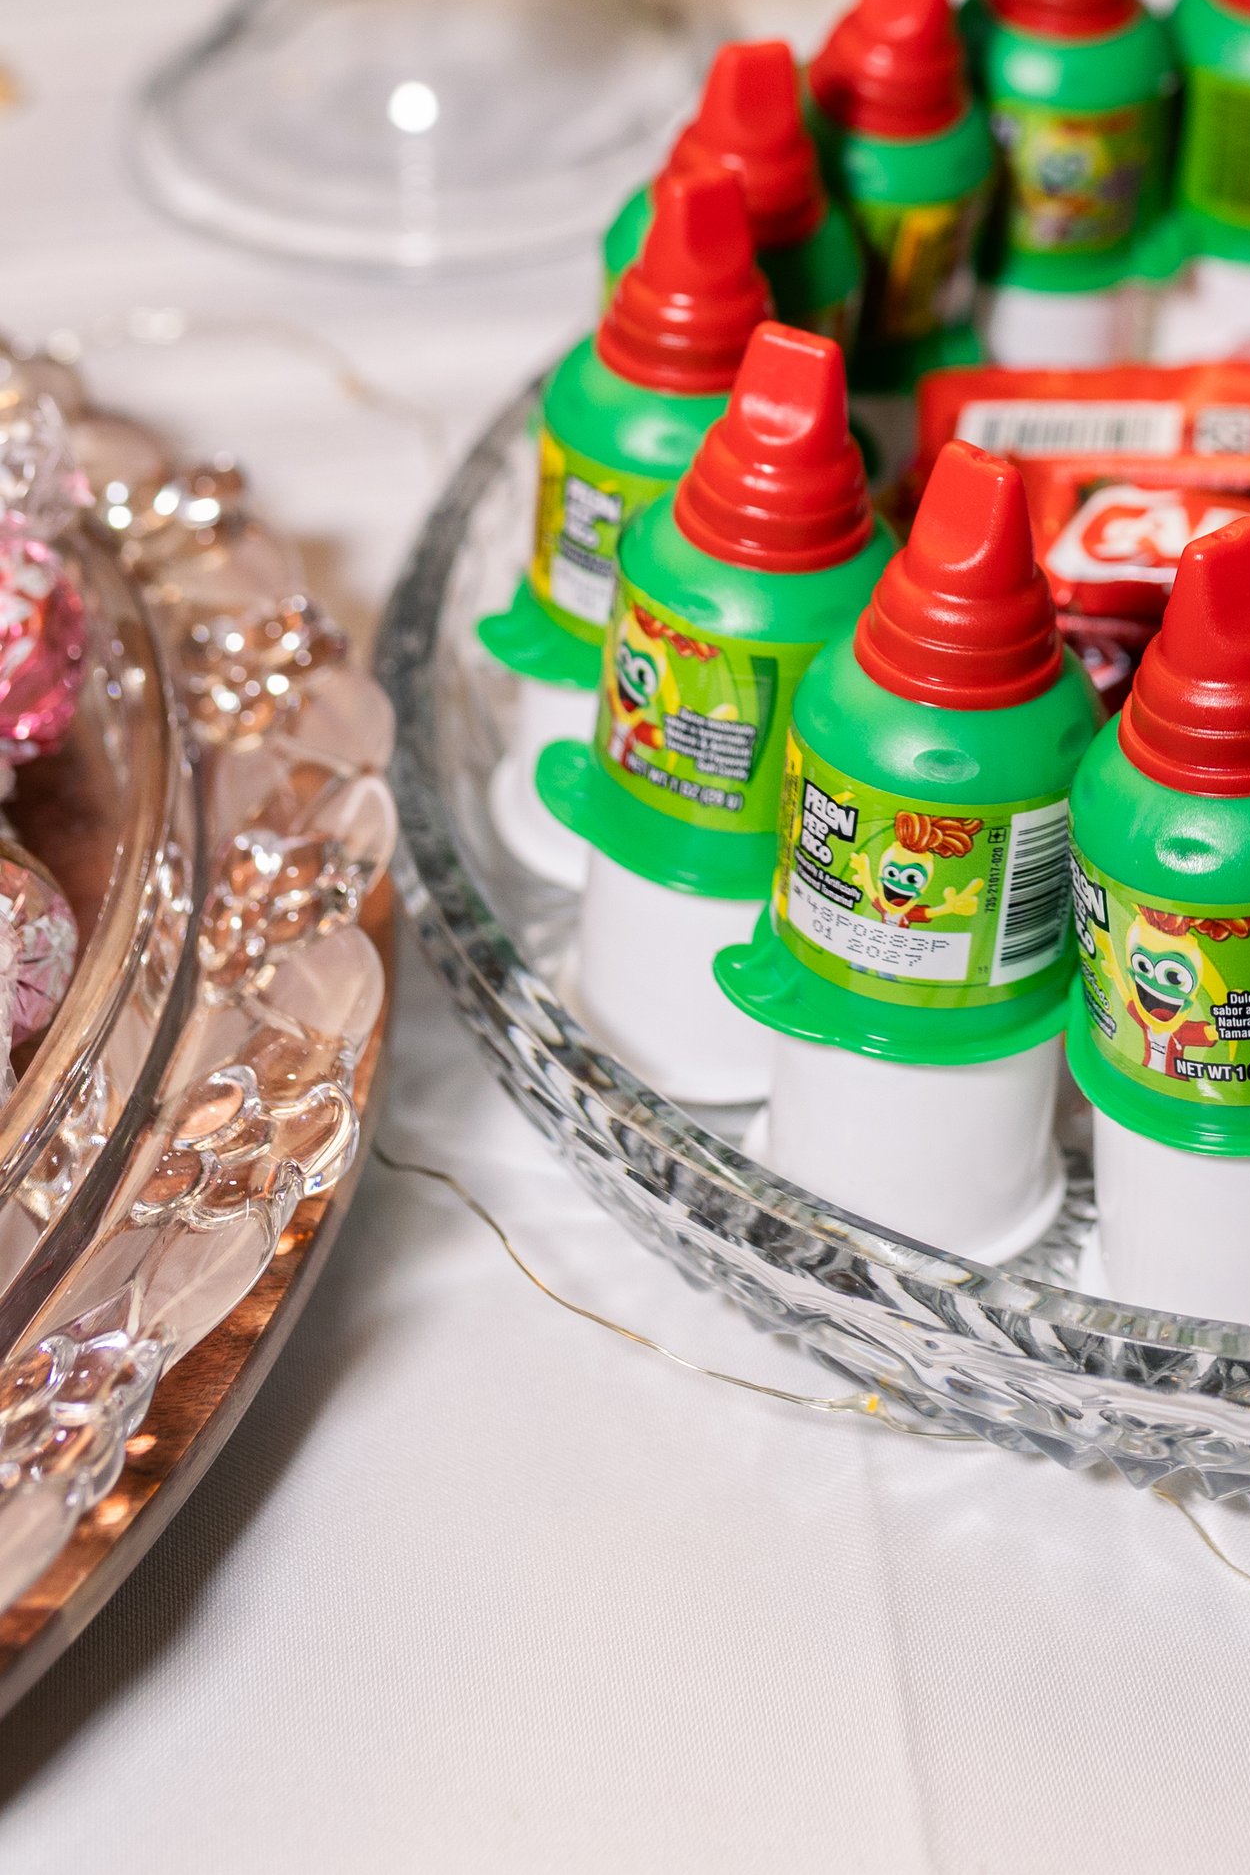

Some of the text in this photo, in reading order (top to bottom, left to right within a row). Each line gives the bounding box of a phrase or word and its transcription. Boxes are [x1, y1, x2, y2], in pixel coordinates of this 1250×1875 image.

[804, 783, 856, 838] PELON
[813, 919, 923, 967] 01 2027
[1213, 1005, 1243, 1016] sabor
[1176, 1059, 1203, 1078] NET
[1207, 1064, 1231, 1080] WT
[1236, 1066, 1244, 1080] 1
